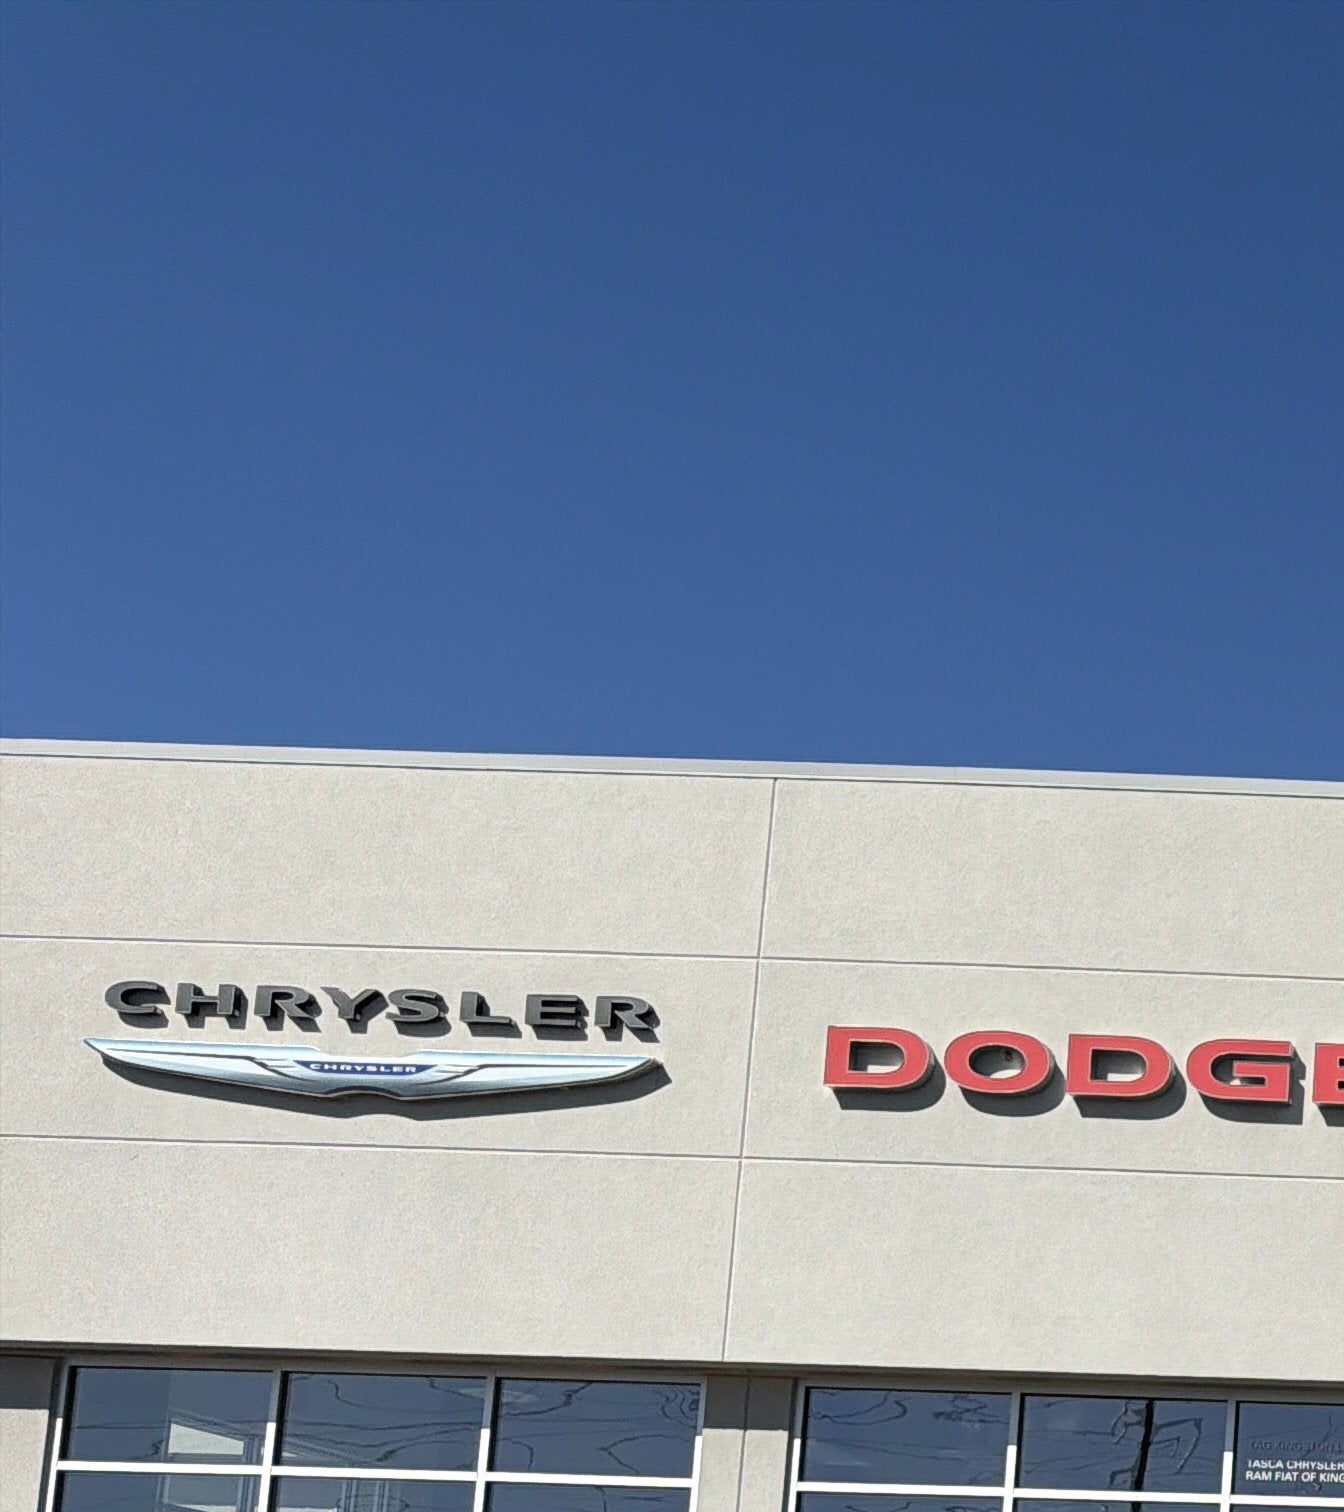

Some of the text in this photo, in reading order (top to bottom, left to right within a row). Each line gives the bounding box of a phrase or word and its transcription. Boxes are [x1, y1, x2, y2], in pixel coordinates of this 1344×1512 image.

[104, 980, 660, 1034] CHRYSLER
[309, 1063, 417, 1073] CHRYSLER
[1246, 1471, 1272, 1481] RAM
[1275, 1471, 1298, 1482] FIAT
[1301, 1472, 1317, 1482] OF
